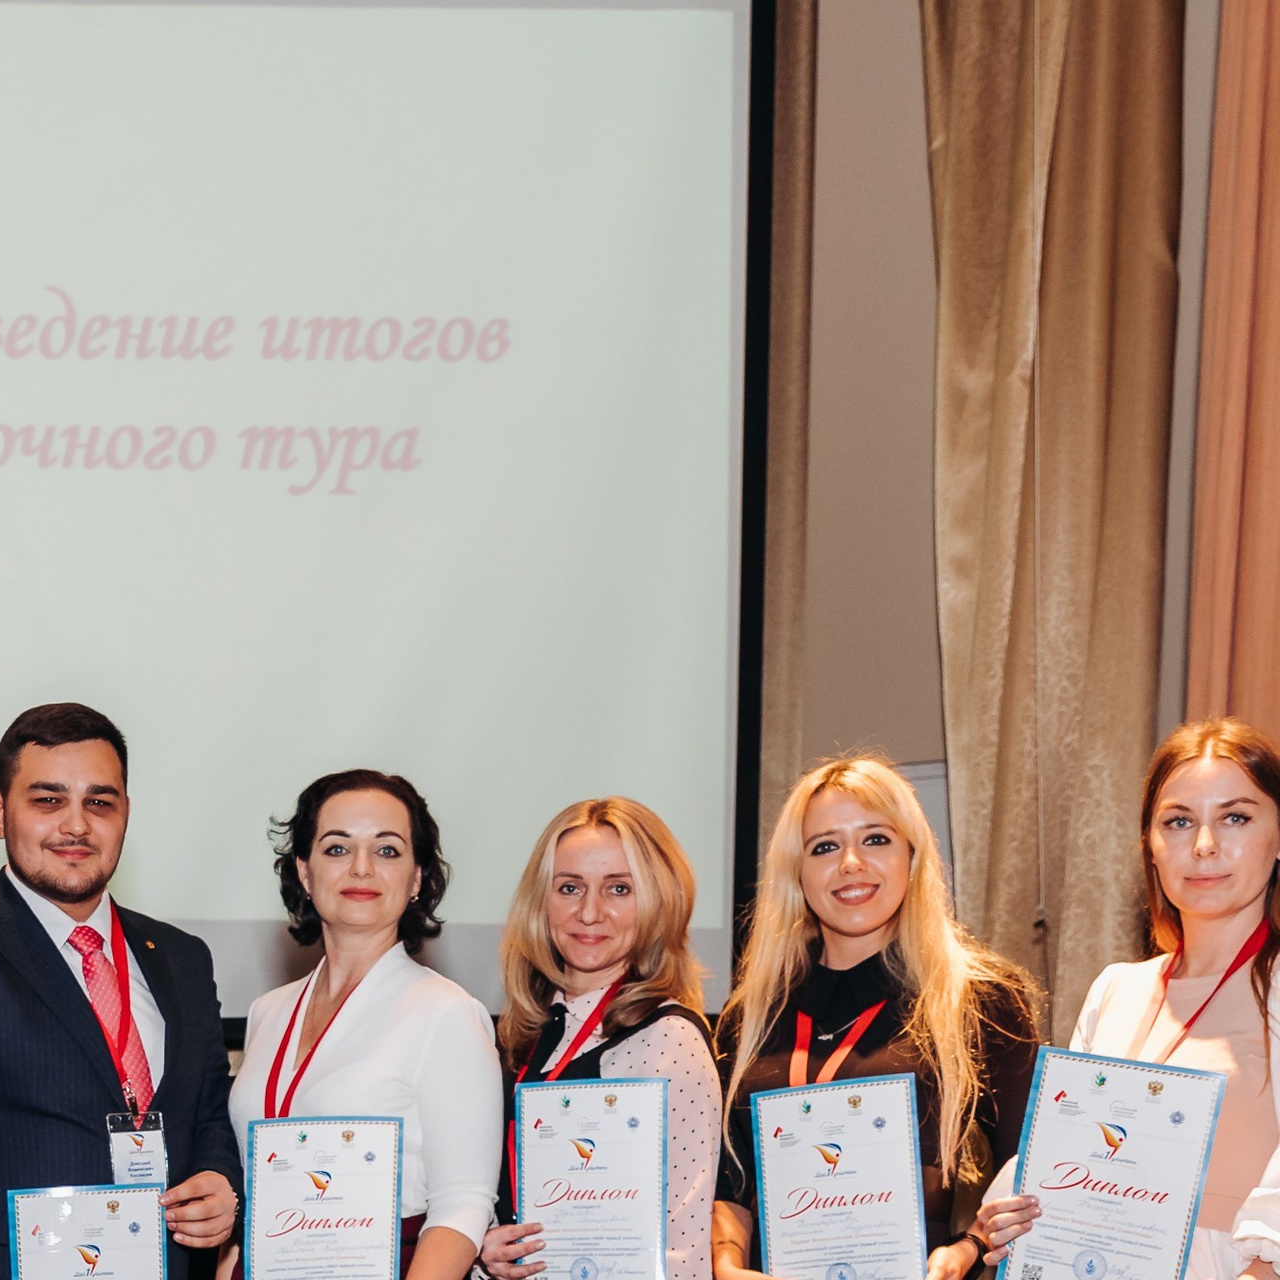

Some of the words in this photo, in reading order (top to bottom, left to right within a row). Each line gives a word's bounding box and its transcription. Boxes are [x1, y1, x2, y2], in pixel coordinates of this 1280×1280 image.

[257, 314, 512, 364] итогов
[236, 423, 423, 497] тура
[534, 1178, 640, 1208] Диплом
[1039, 1161, 1169, 1204] Диплом
[779, 1186, 894, 1220] Диплом
[265, 1208, 376, 1238] Диплом
